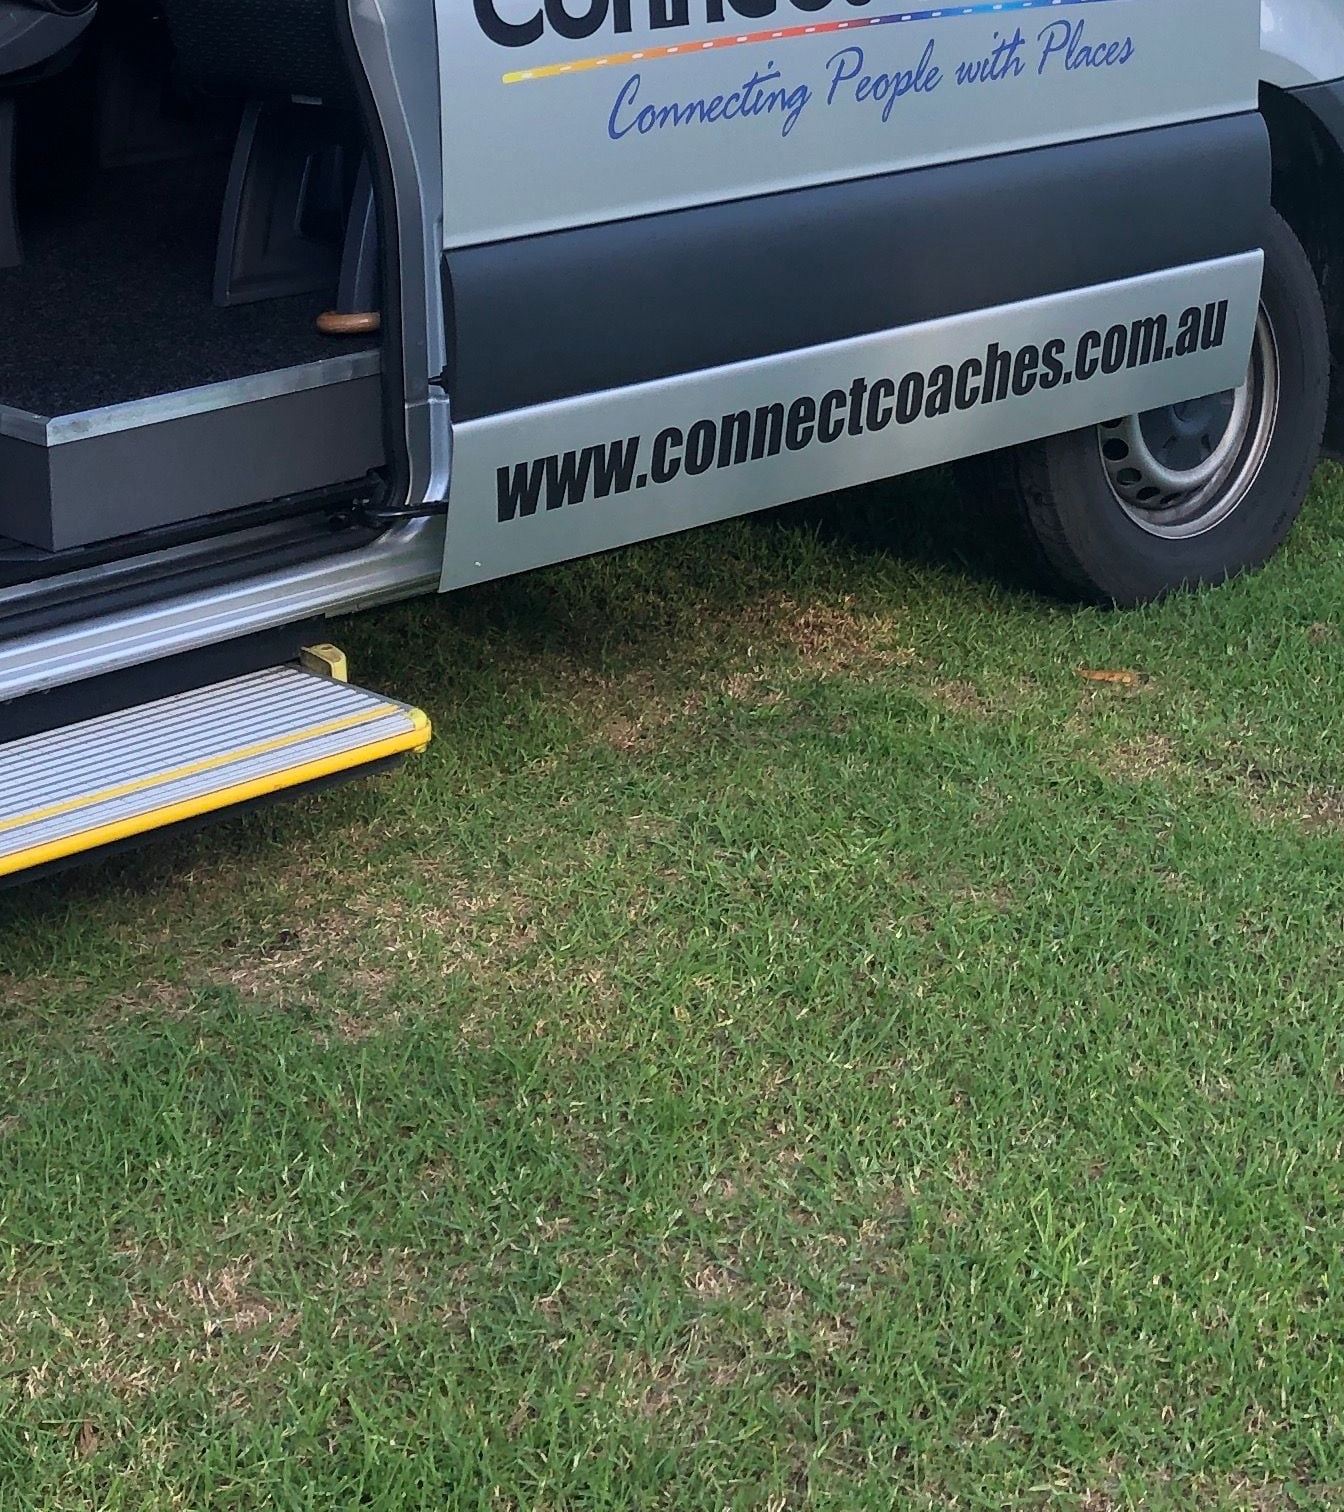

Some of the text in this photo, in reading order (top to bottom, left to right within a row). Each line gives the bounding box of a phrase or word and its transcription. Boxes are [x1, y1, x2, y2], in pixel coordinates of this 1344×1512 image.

[608, 19, 1136, 142] Connecting People with Places
[495, 299, 1229, 524] www.connectcoaches.com.au
